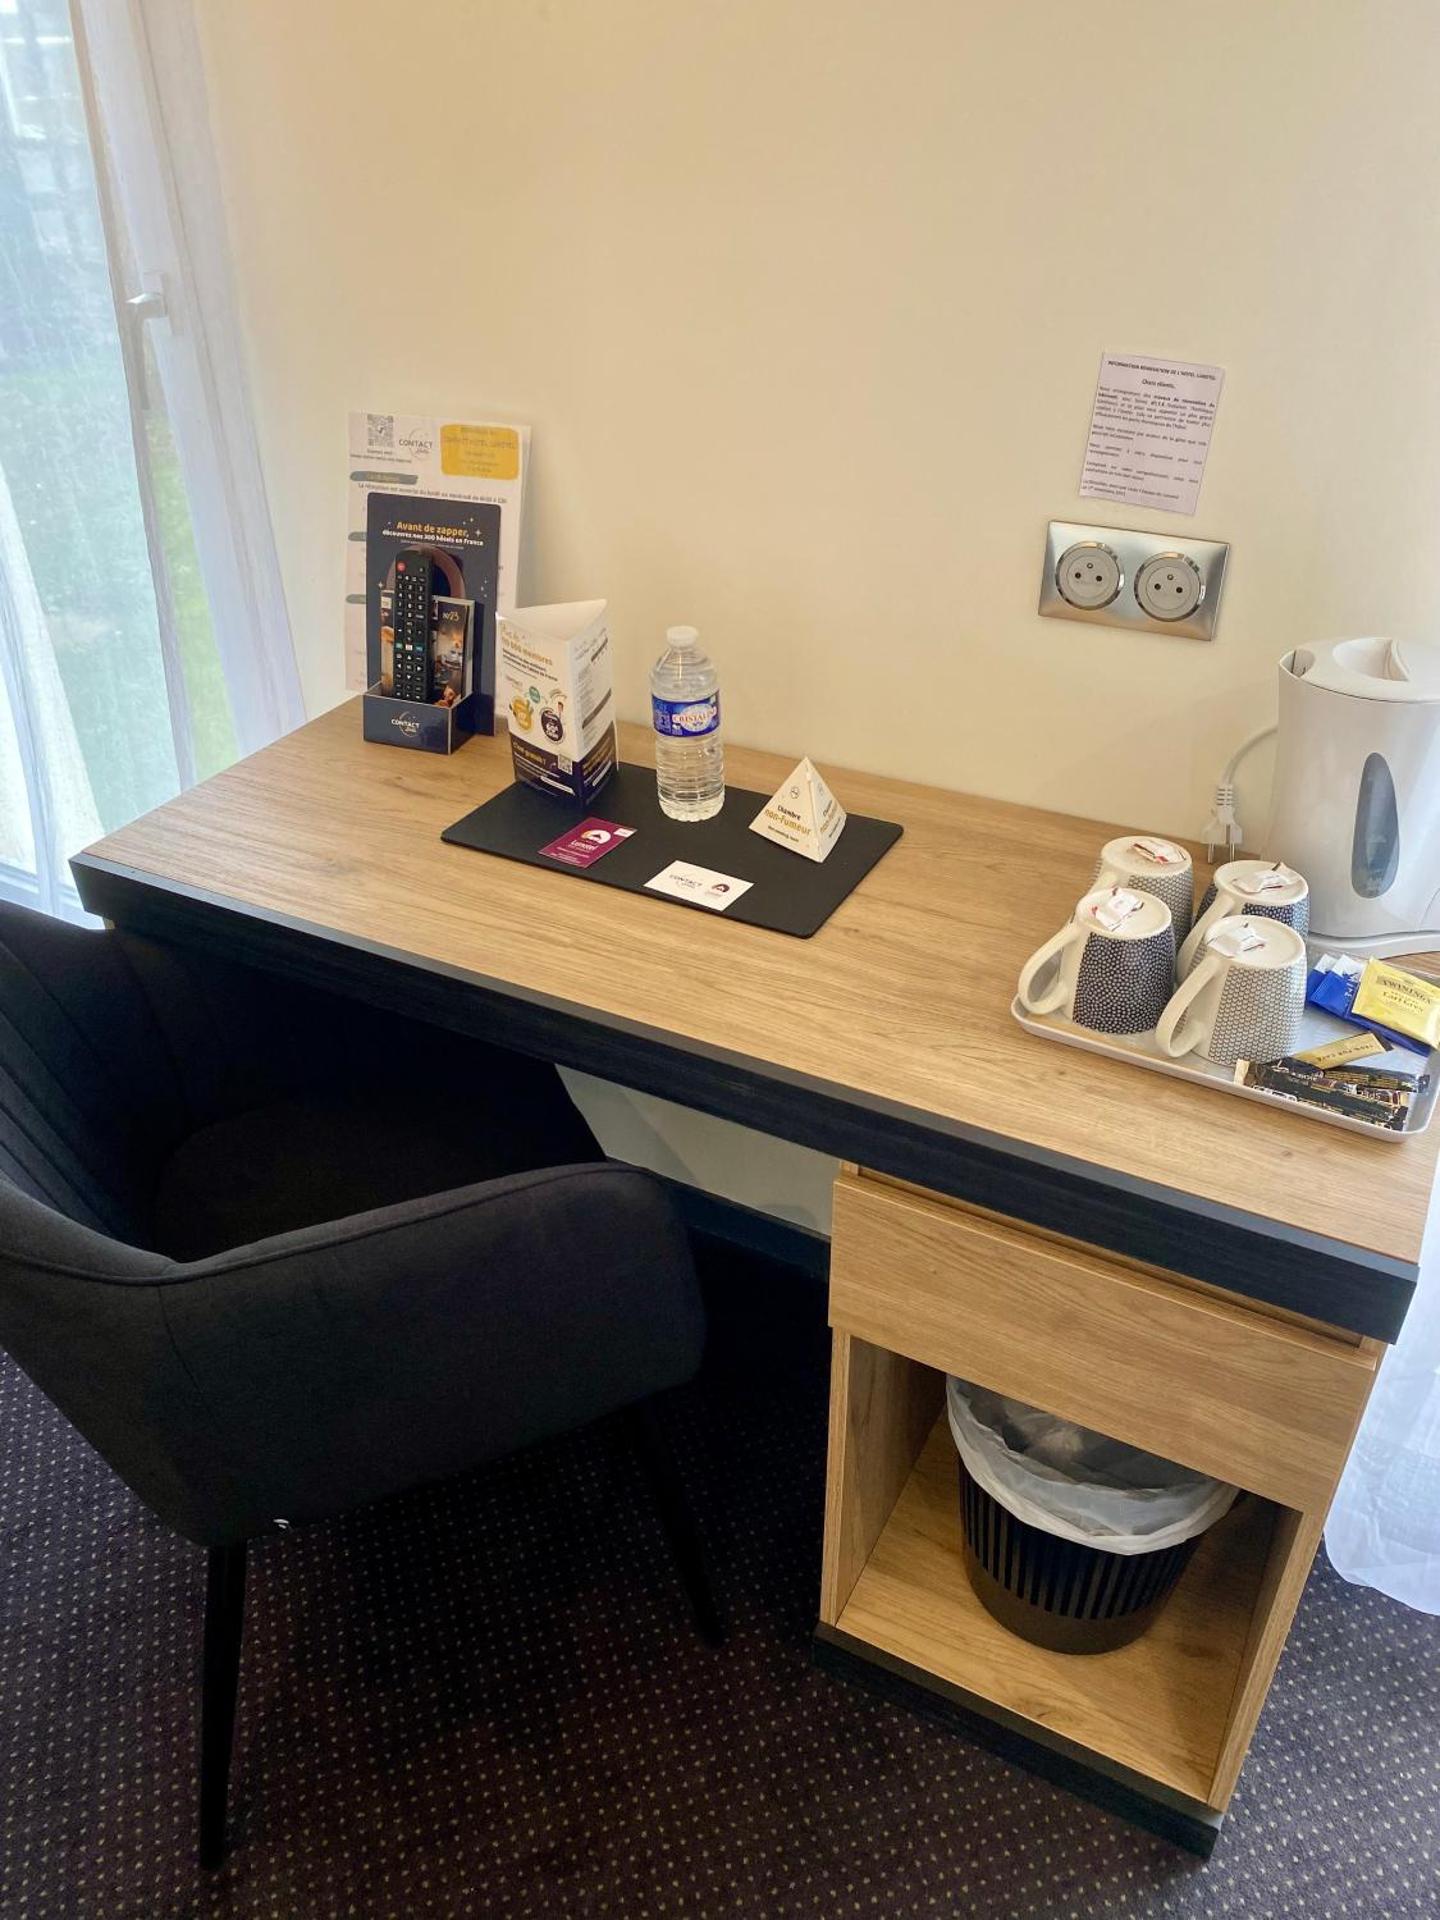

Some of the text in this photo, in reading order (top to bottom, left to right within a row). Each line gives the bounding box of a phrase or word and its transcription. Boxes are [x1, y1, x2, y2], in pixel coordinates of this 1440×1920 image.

[399, 439, 432, 449] CONTACT
[397, 521, 469, 538] Avant de zapper,
[391, 719, 419, 729] CONTACT
[777, 804, 801, 821] Chambre
[765, 808, 812, 835] non-fumeur
